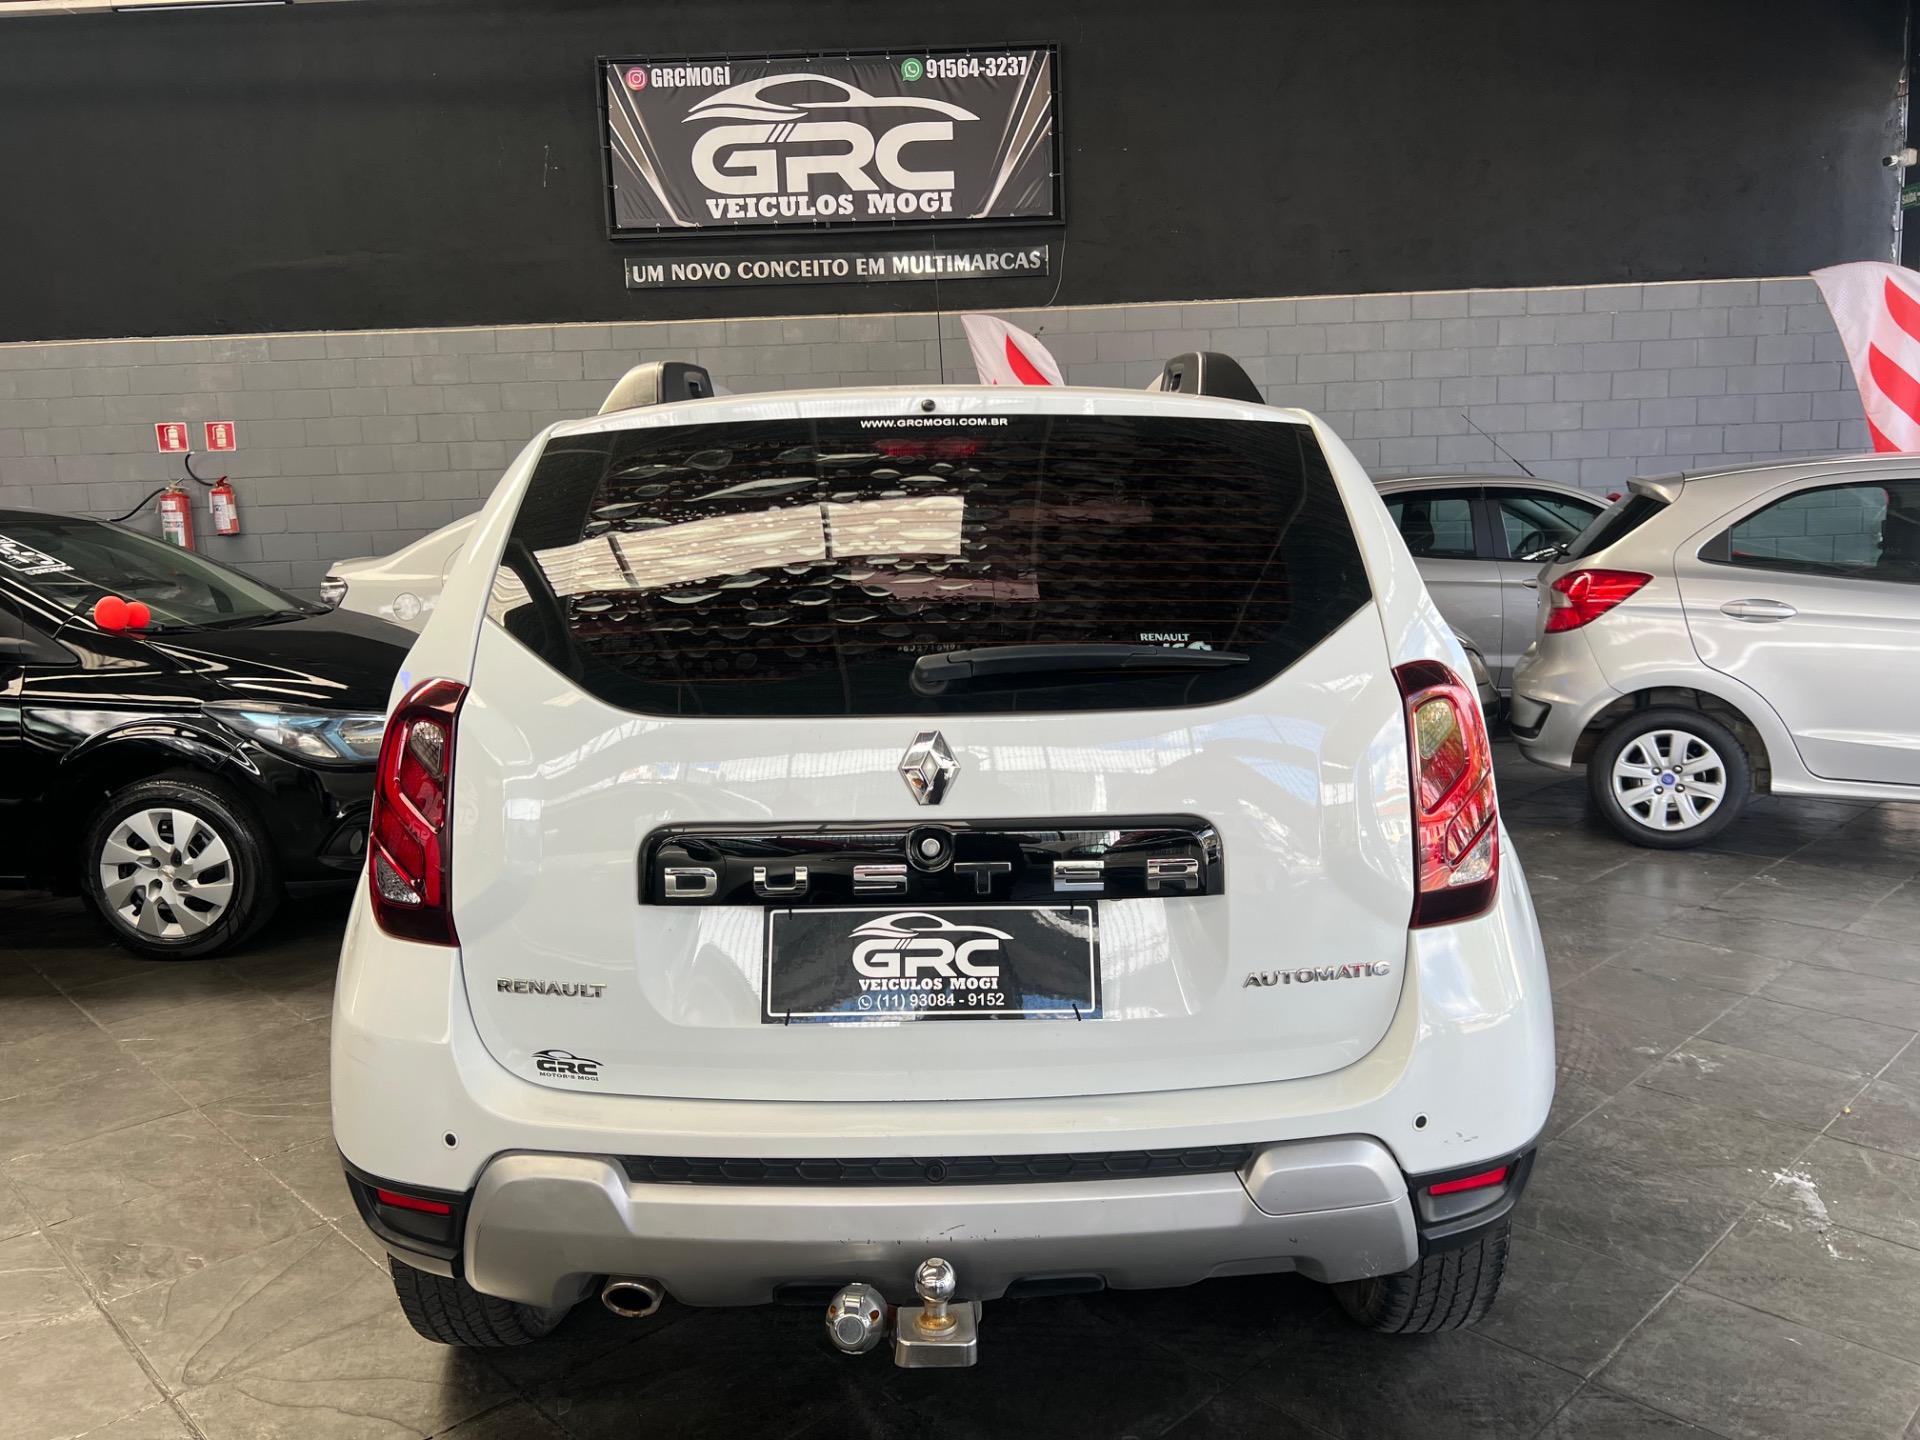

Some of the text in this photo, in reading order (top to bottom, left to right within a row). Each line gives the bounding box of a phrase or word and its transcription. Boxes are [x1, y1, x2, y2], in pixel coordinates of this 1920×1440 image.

[651, 67, 731, 88] GRCMOGI
[926, 56, 1028, 80] 91564-3237
[692, 121, 955, 194] GRC
[706, 191, 953, 219] VEICULOS MOGI
[632, 251, 1041, 283] UM NOVO CONCEITO EM MULTIMARCAS
[860, 418, 1008, 428] WWW.GRCMOGI.COM.BR
[1140, 633, 1190, 641] RENAULT
[665, 860, 1198, 898] DUSTER
[852, 938, 999, 977] GRC
[859, 977, 998, 991] VEICULOS MOGI
[1242, 960, 1391, 989] AUTOMATIC
[497, 978, 607, 998] RENAULT
[877, 993, 905, 1010] (11)
[909, 993, 955, 1007] 93084
[968, 992, 1005, 1007] 9152
[537, 1059, 598, 1076] GRC
